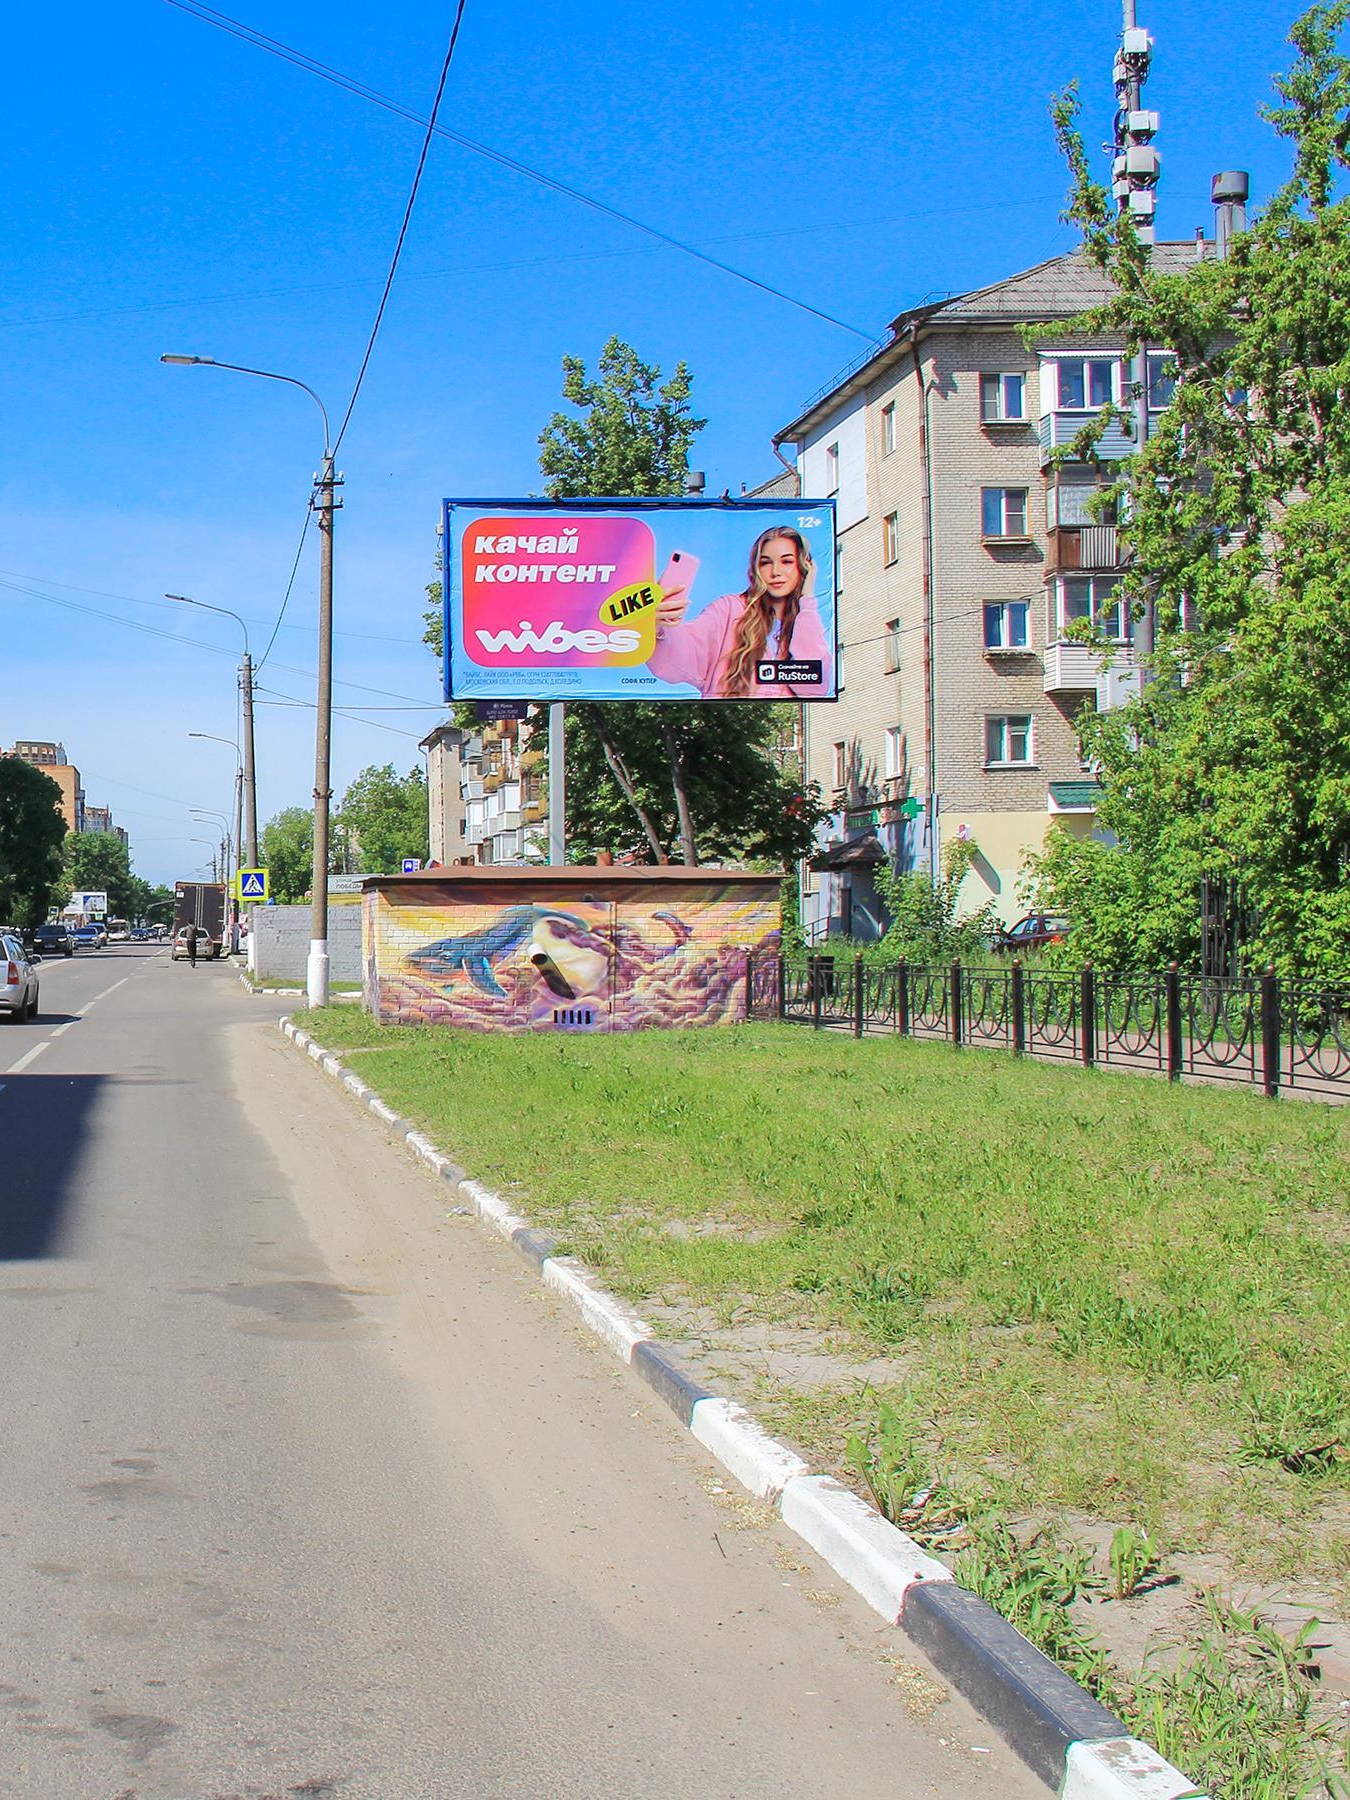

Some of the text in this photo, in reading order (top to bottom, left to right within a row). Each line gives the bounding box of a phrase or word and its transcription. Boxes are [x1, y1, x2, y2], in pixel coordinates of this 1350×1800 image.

[797, 516, 821, 528] 12+
[474, 528, 579, 554] качай
[474, 564, 616, 583] контент
[609, 587, 655, 622] LIKE
[778, 671, 818, 681] RuStore
